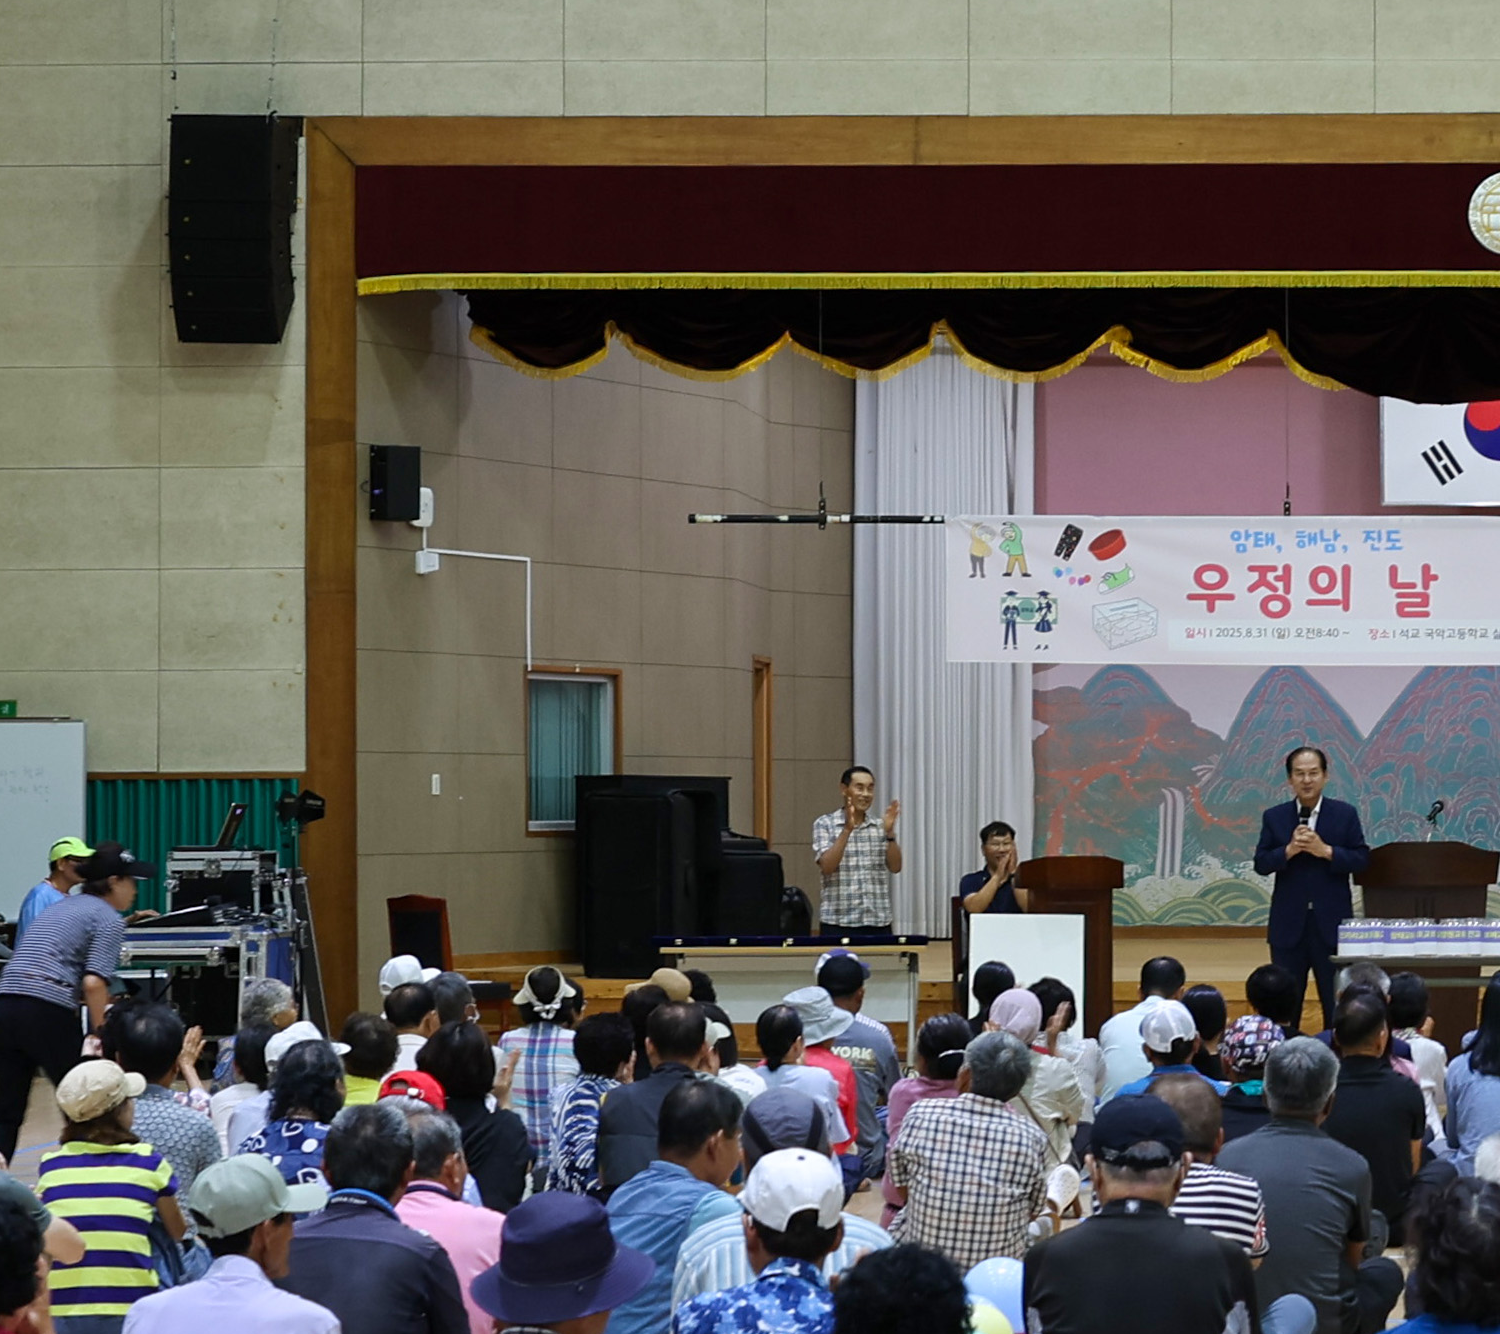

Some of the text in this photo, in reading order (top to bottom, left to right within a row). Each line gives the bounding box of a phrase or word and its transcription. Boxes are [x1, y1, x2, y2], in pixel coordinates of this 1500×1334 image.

[1229, 528, 1405, 555] 암태, 해남, 진도
[1186, 564, 1439, 620] 우정의 날
[1185, 627, 1206, 640] 일시
[1215, 627, 1268, 639] 2025.8.31
[1271, 627, 1291, 640] (일)
[1293, 627, 1340, 640] 오전8:40
[1368, 628, 1390, 641] 장소
[1399, 628, 1421, 640] 석교
[1424, 628, 1490, 640] 국악고등학교
[830, 1046, 874, 1061] YORK
